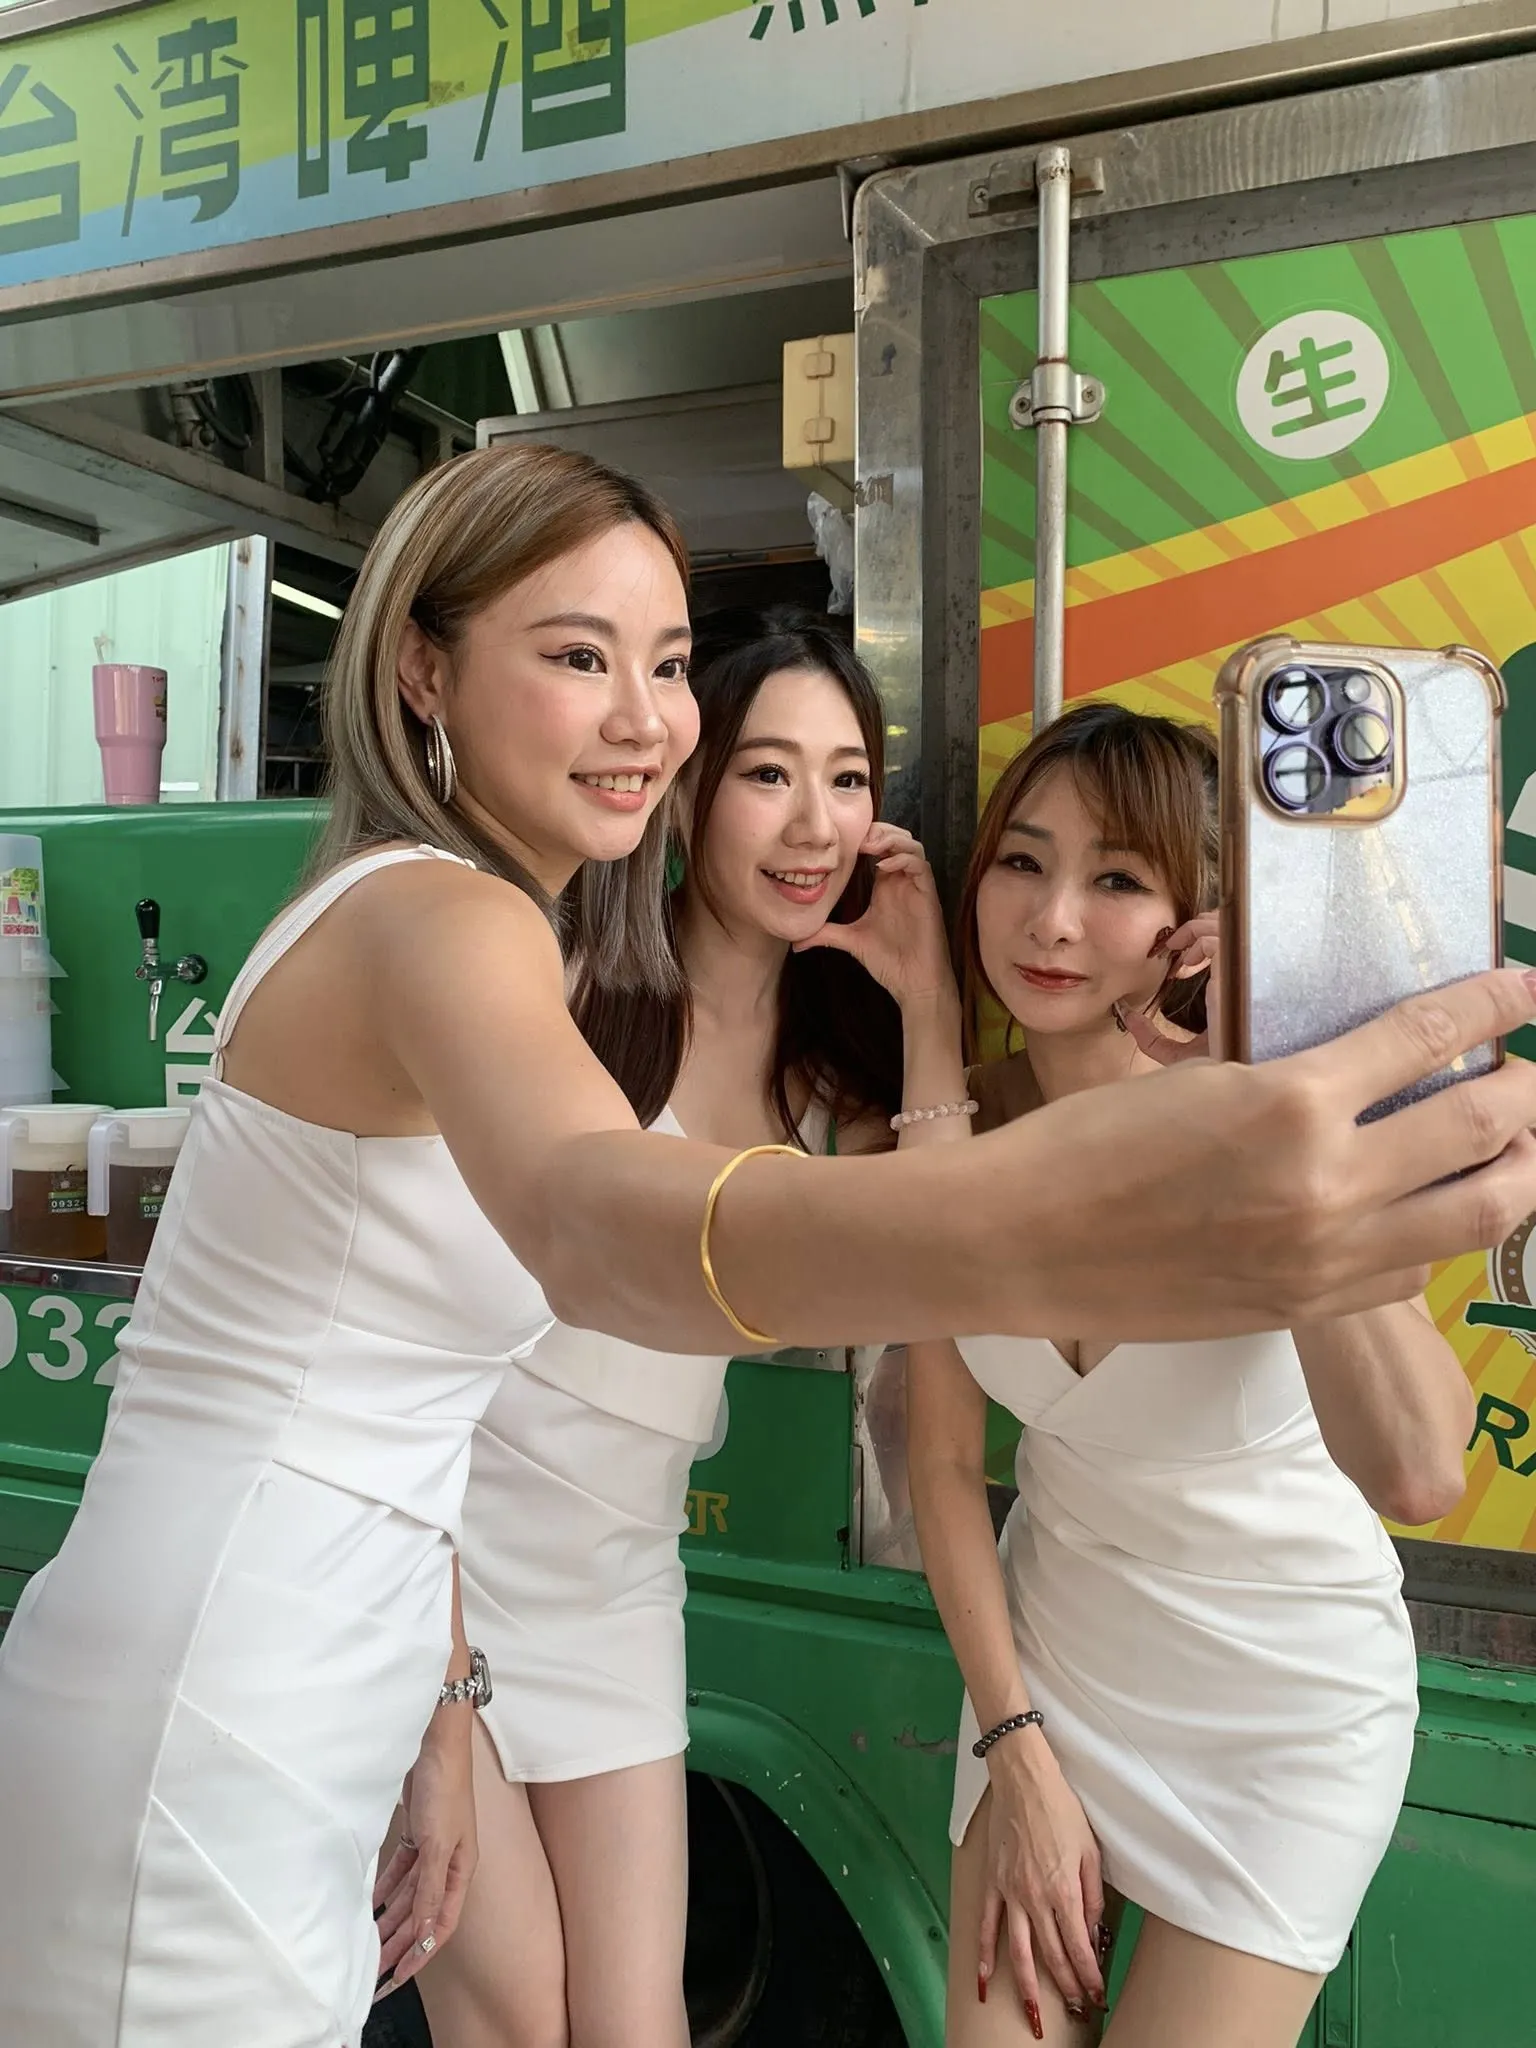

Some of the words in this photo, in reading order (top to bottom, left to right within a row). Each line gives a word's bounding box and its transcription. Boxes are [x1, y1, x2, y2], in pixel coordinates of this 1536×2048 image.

[1264, 337, 1366, 437] 生
[143, 1205, 162, 1213] 09
[1466, 1392, 1536, 1477] R
